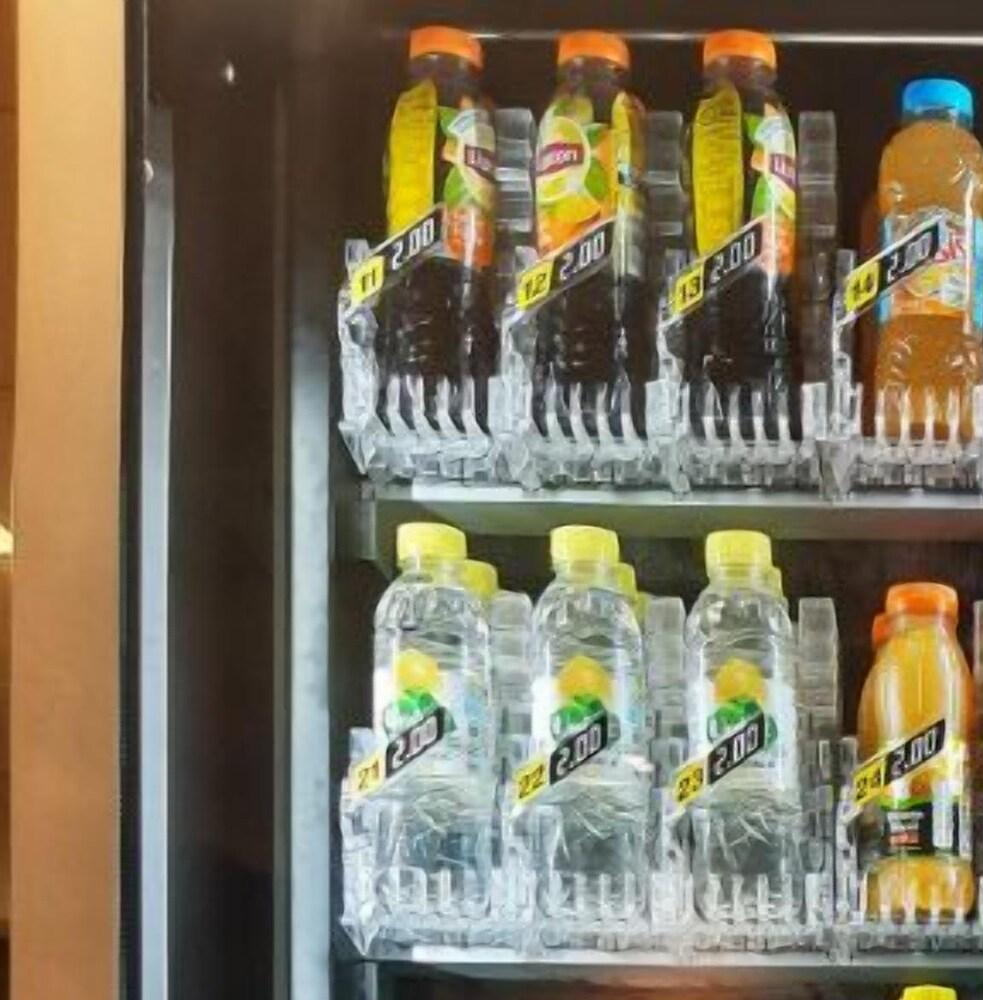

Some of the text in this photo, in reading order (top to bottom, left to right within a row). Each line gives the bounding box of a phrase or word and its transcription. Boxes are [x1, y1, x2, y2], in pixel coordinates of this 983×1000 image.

[361, 217, 434, 292] 11 2.00
[525, 231, 605, 300] 12 2.00
[681, 231, 755, 304] 13 2.00
[555, 724, 600, 776] 2.00
[713, 724, 759, 776] 2.00
[890, 729, 936, 779] 2.00
